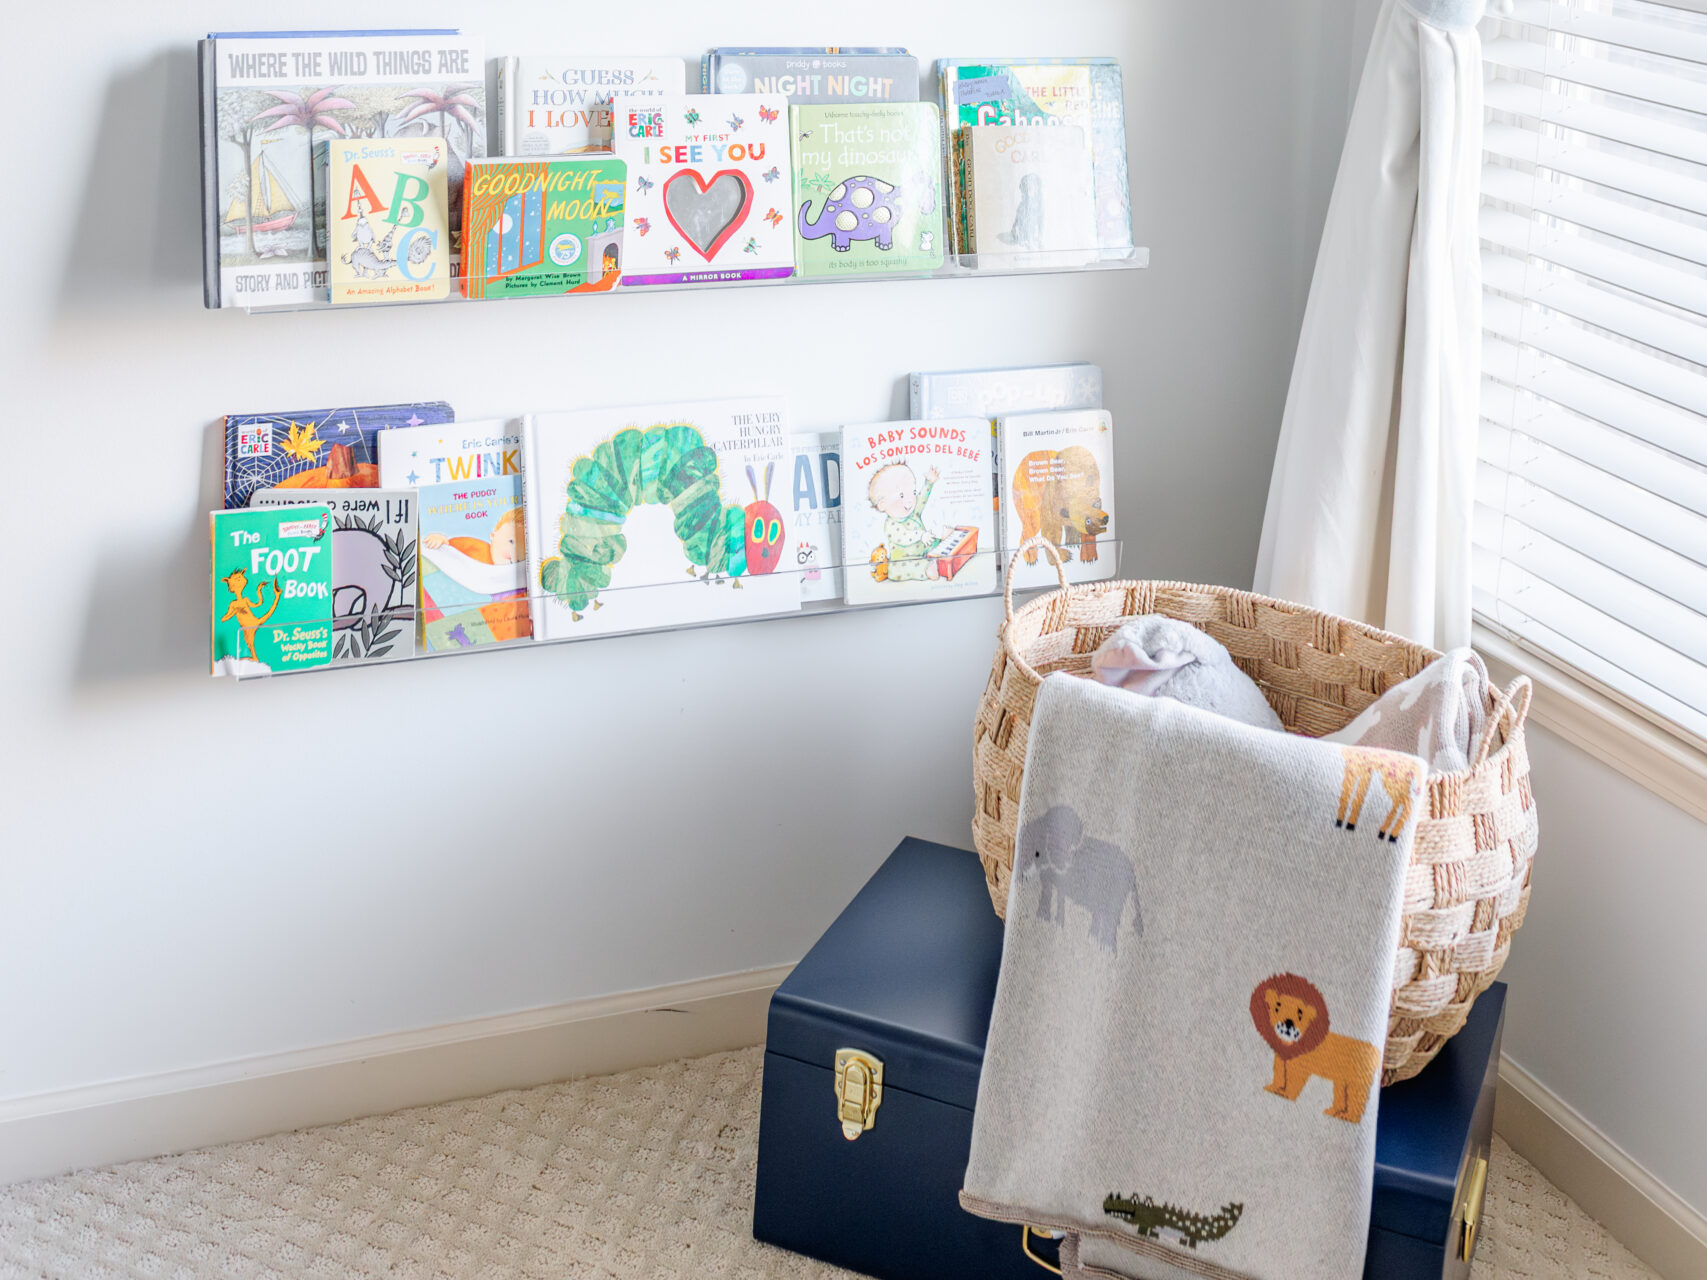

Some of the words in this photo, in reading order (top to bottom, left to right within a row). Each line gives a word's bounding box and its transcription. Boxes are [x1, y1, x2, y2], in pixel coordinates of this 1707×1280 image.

[228, 52, 287, 79] WHERE
[291, 52, 322, 78] THE
[328, 50, 367, 77] WILD
[373, 49, 432, 76] THINGS
[437, 48, 470, 74] ARE
[786, 60, 810, 70] priddy
[822, 58, 848, 69] books
[562, 69, 635, 85] GUESS
[754, 75, 822, 96] NIGHT
[827, 75, 893, 99] NIGHT
[1025, 86, 1047, 97] THE
[531, 89, 589, 106] HOW
[528, 110, 536, 128] I
[545, 110, 611, 129] LOVE
[628, 113, 663, 126] ERIC
[628, 125, 664, 138] CARLE
[703, 133, 730, 142] FIRST
[819, 121, 874, 144] That's
[880, 125, 911, 144] not
[343, 150, 360, 163] Dr.
[361, 146, 396, 160] Seuss's
[644, 146, 650, 165] I
[659, 145, 704, 164] SEE
[711, 142, 766, 162] YOU
[802, 151, 831, 170] my
[473, 170, 602, 196] GOODNIGHT
[546, 199, 612, 220] MOON
[235, 274, 270, 293] STORY
[275, 272, 299, 290] AND
[515, 274, 542, 282] Margaret
[689, 273, 718, 281] MIRROR
[720, 271, 742, 280] BOOK
[346, 287, 356, 295] An
[357, 286, 385, 296] Amazing
[385, 285, 414, 295] Alphabet
[731, 415, 753, 426] THE
[755, 412, 781, 424] VERY
[241, 433, 269, 444] ERIC
[739, 424, 781, 437] HUNGRY
[867, 429, 904, 449] BABY
[909, 426, 966, 442] SOUNDS
[241, 443, 270, 455] CARLE
[462, 439, 483, 449] Eric
[484, 435, 520, 447] Carle's
[714, 436, 783, 453] CATERPILLAR
[855, 453, 878, 470] LOS
[880, 443, 931, 460] SONIDOS
[934, 444, 953, 455] DEL
[957, 446, 981, 462] BEBÉ
[429, 449, 520, 483] TWINK
[453, 492, 468, 501] THE
[470, 488, 497, 499] PUDGY
[342, 500, 380, 512] were
[386, 500, 390, 524] I
[394, 499, 409, 524] If
[427, 502, 468, 515] WHERE
[472, 500, 485, 510] IS
[487, 495, 519, 508] YOUR
[465, 510, 488, 520] BOOK
[230, 530, 261, 547] The
[250, 546, 321, 576] FOOT
[283, 579, 329, 600] BOOK
[273, 629, 290, 643] Dr.
[291, 626, 328, 640] Seuss's
[281, 643, 306, 652] Wacky
[307, 640, 328, 650] Book
[282, 652, 292, 662] of
[292, 649, 328, 662] Opposites
